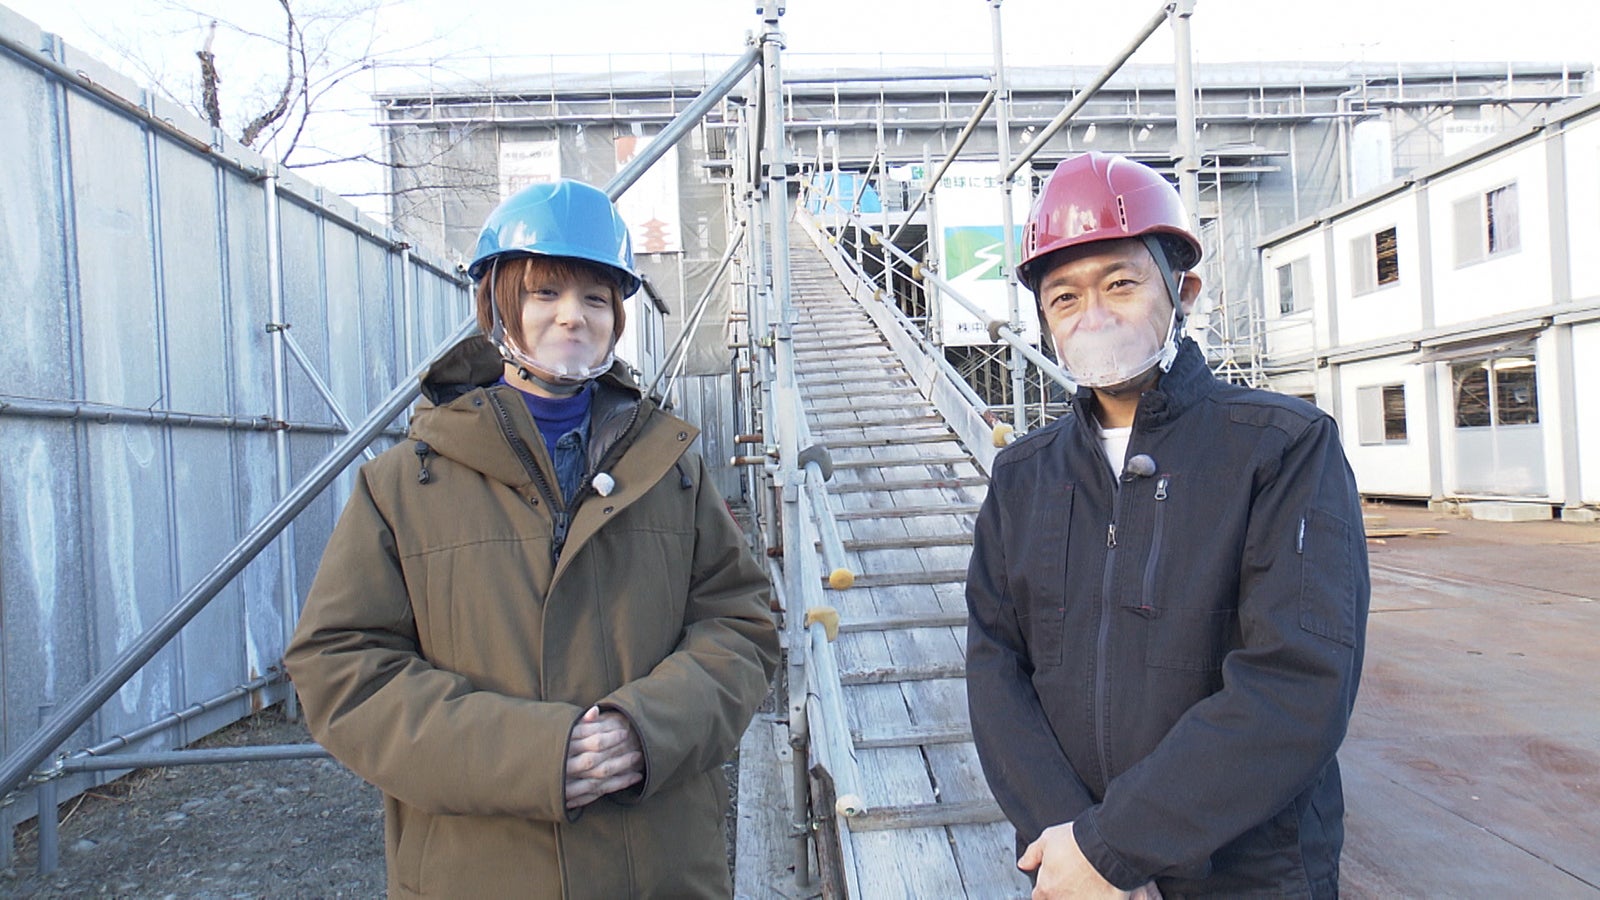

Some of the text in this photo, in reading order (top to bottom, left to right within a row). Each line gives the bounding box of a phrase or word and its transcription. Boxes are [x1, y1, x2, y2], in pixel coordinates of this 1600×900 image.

[939, 175, 1026, 189] 地球に生る
